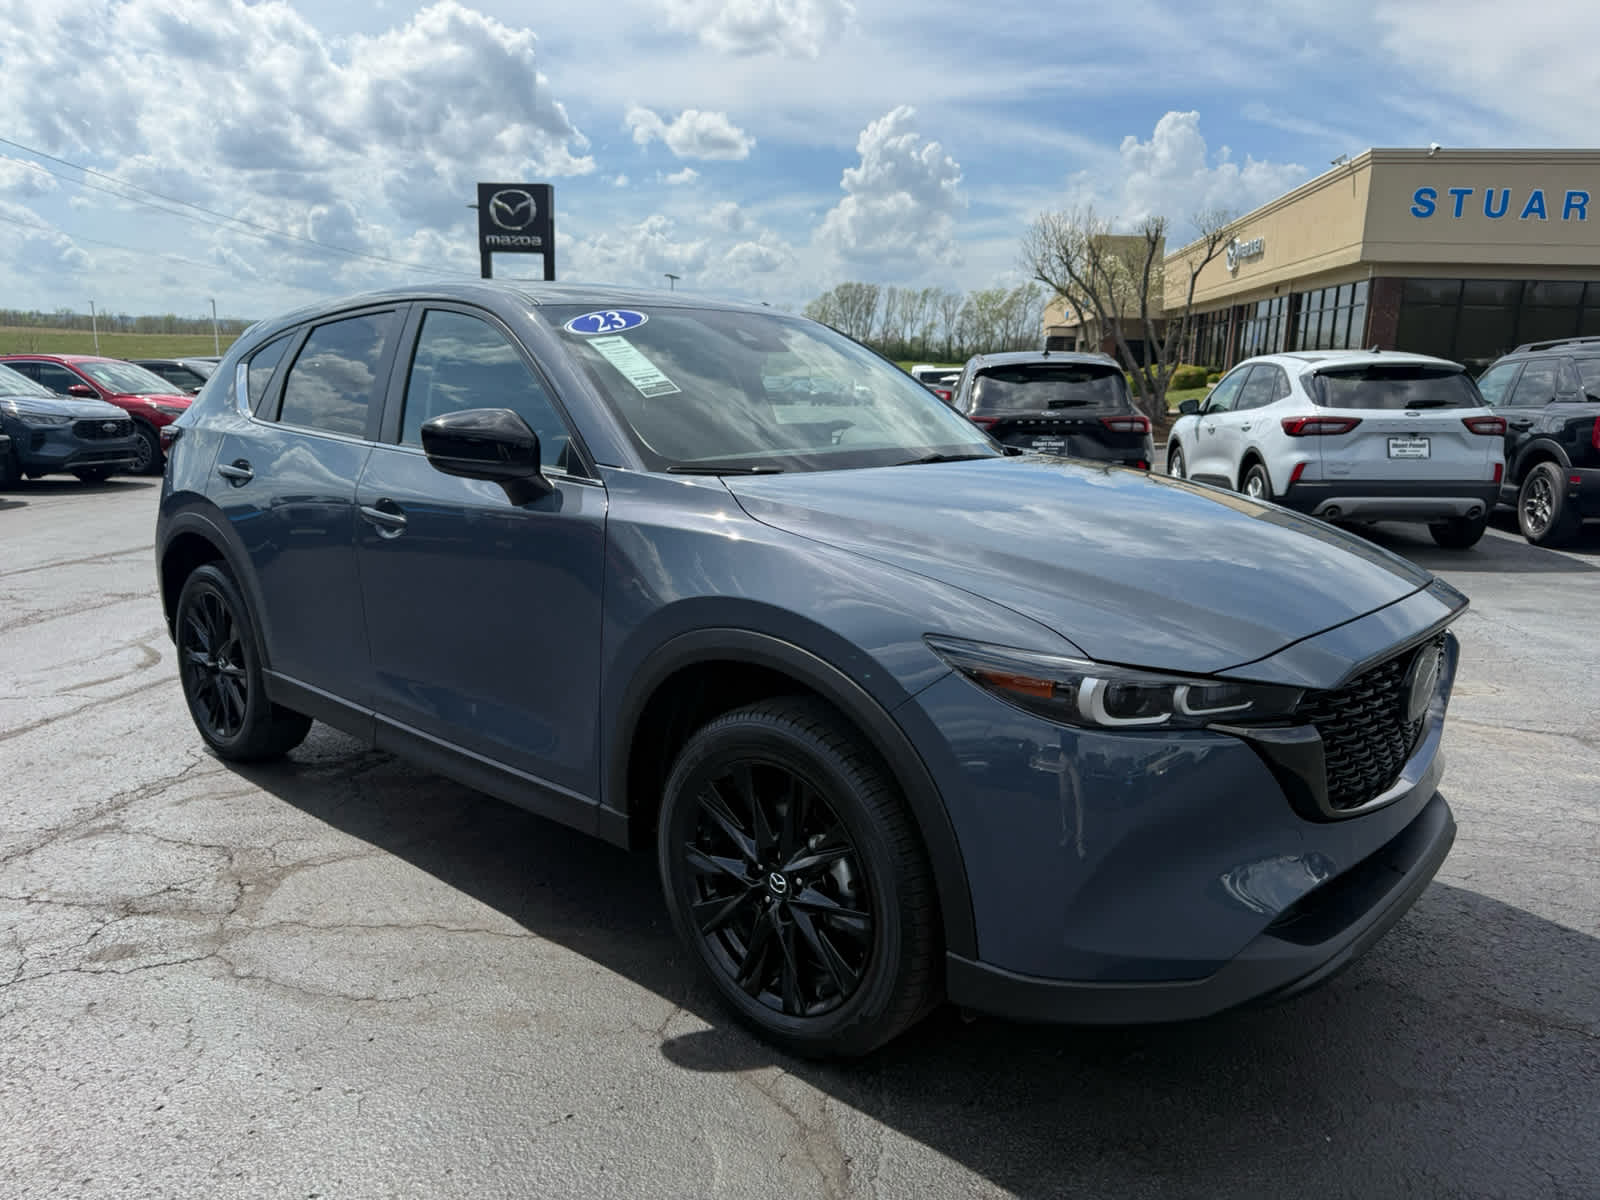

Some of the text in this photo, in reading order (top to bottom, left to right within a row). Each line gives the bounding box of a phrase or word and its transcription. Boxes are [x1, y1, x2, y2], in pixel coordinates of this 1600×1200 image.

[1410, 186, 1592, 222] STUAR
[485, 234, 542, 247] mazda
[588, 310, 627, 333] 23
